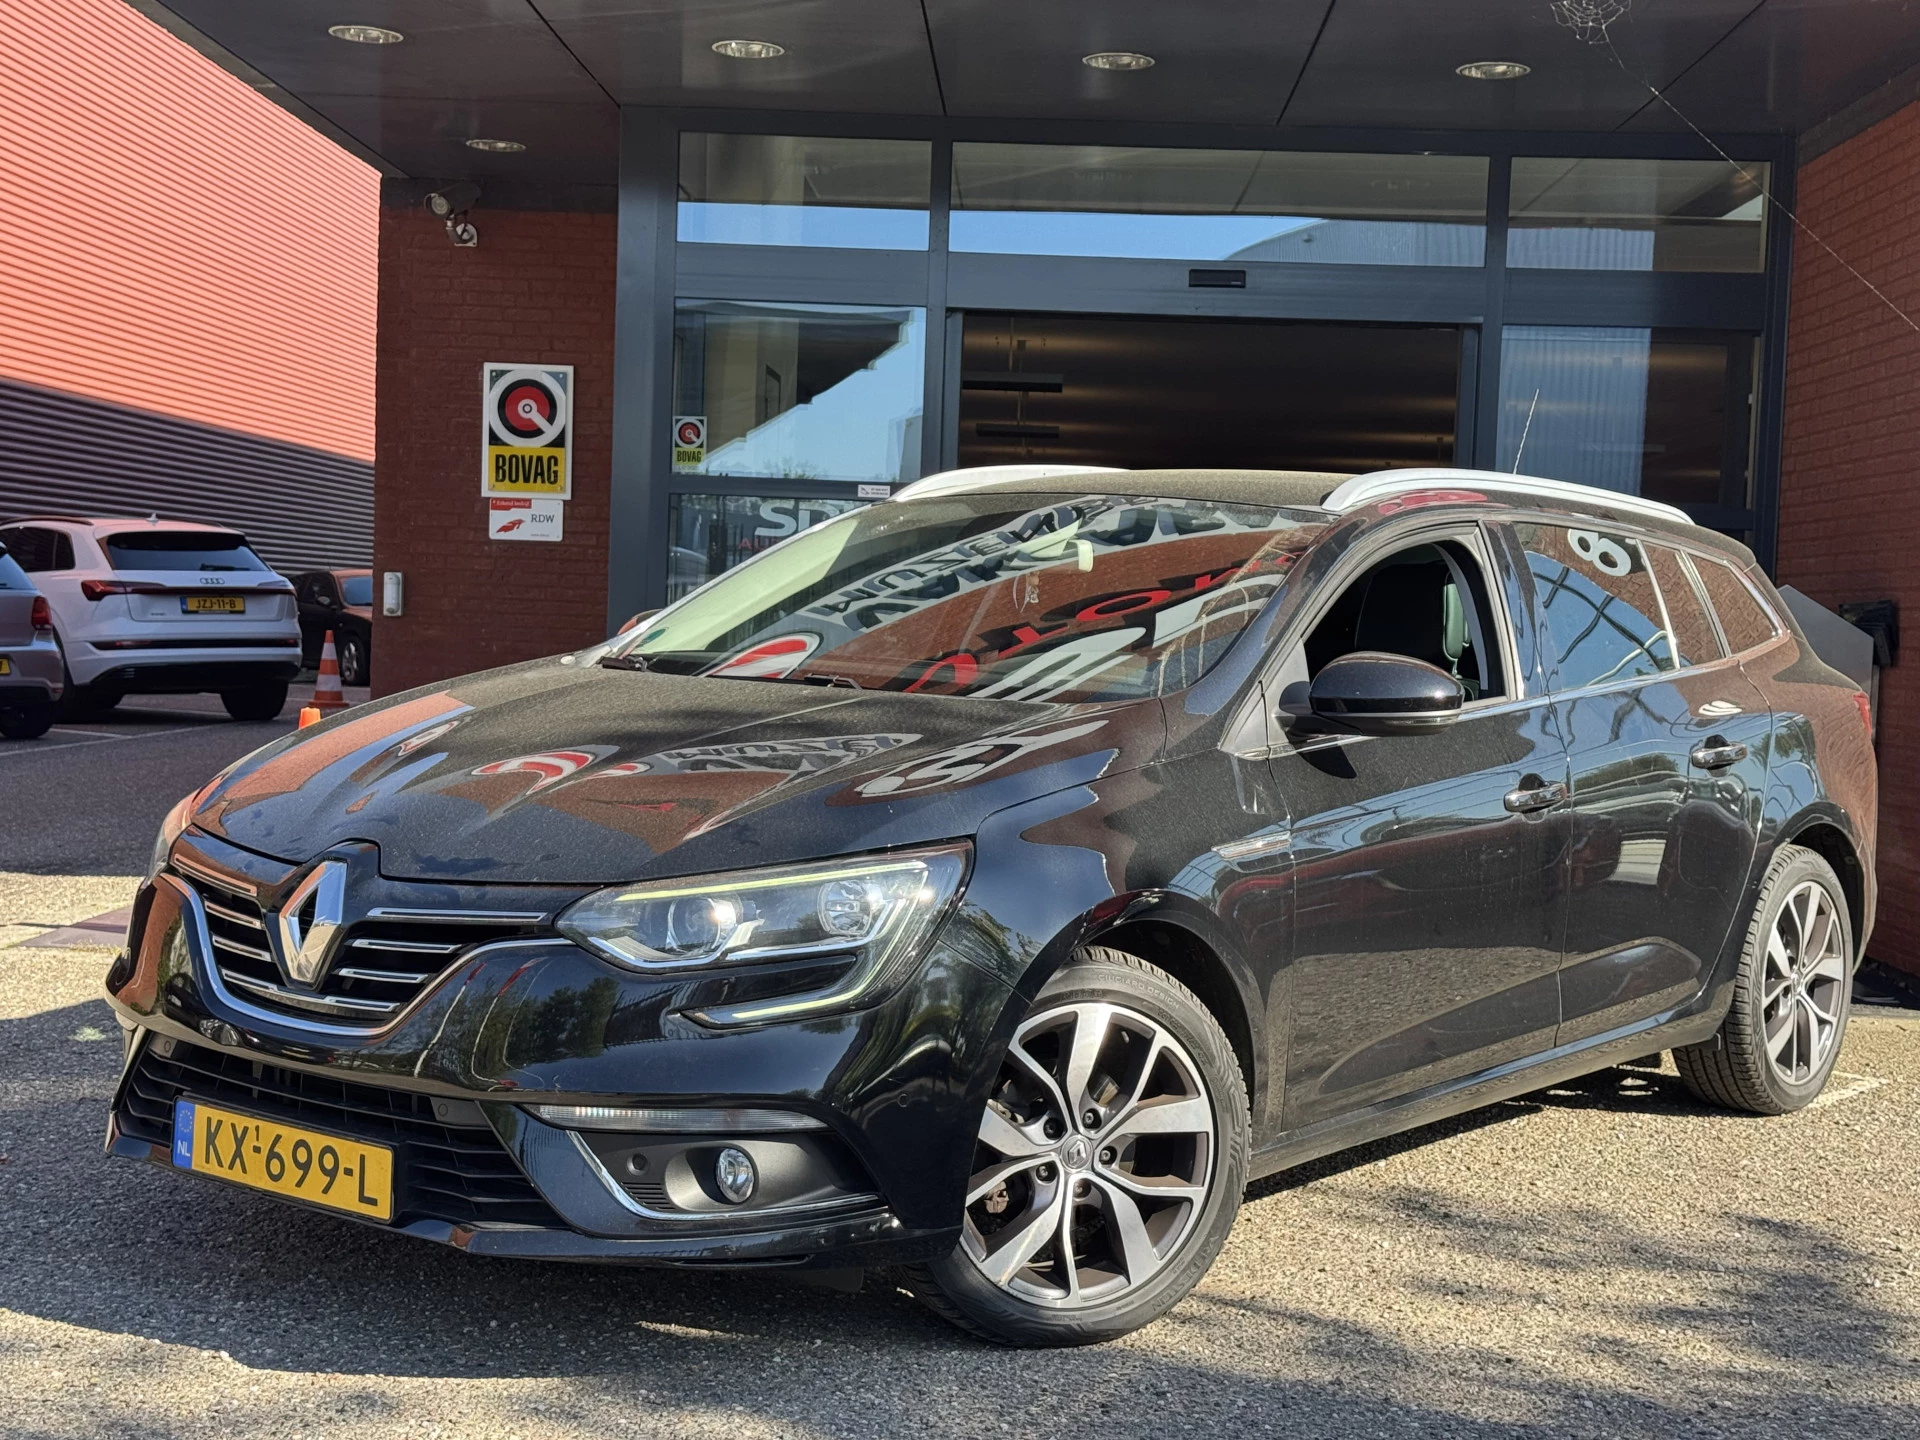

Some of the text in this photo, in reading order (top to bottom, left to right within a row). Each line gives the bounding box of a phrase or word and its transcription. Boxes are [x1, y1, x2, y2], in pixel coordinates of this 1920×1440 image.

[677, 451, 702, 463] BOVAG
[495, 454, 559, 485] BOVAG
[531, 514, 555, 523] RDW
[196, 599, 236, 609] JZJ-11-B
[1147, 986, 1180, 1009] DESIGN
[177, 1140, 191, 1157] NL
[205, 1116, 378, 1206] KX-699-L
